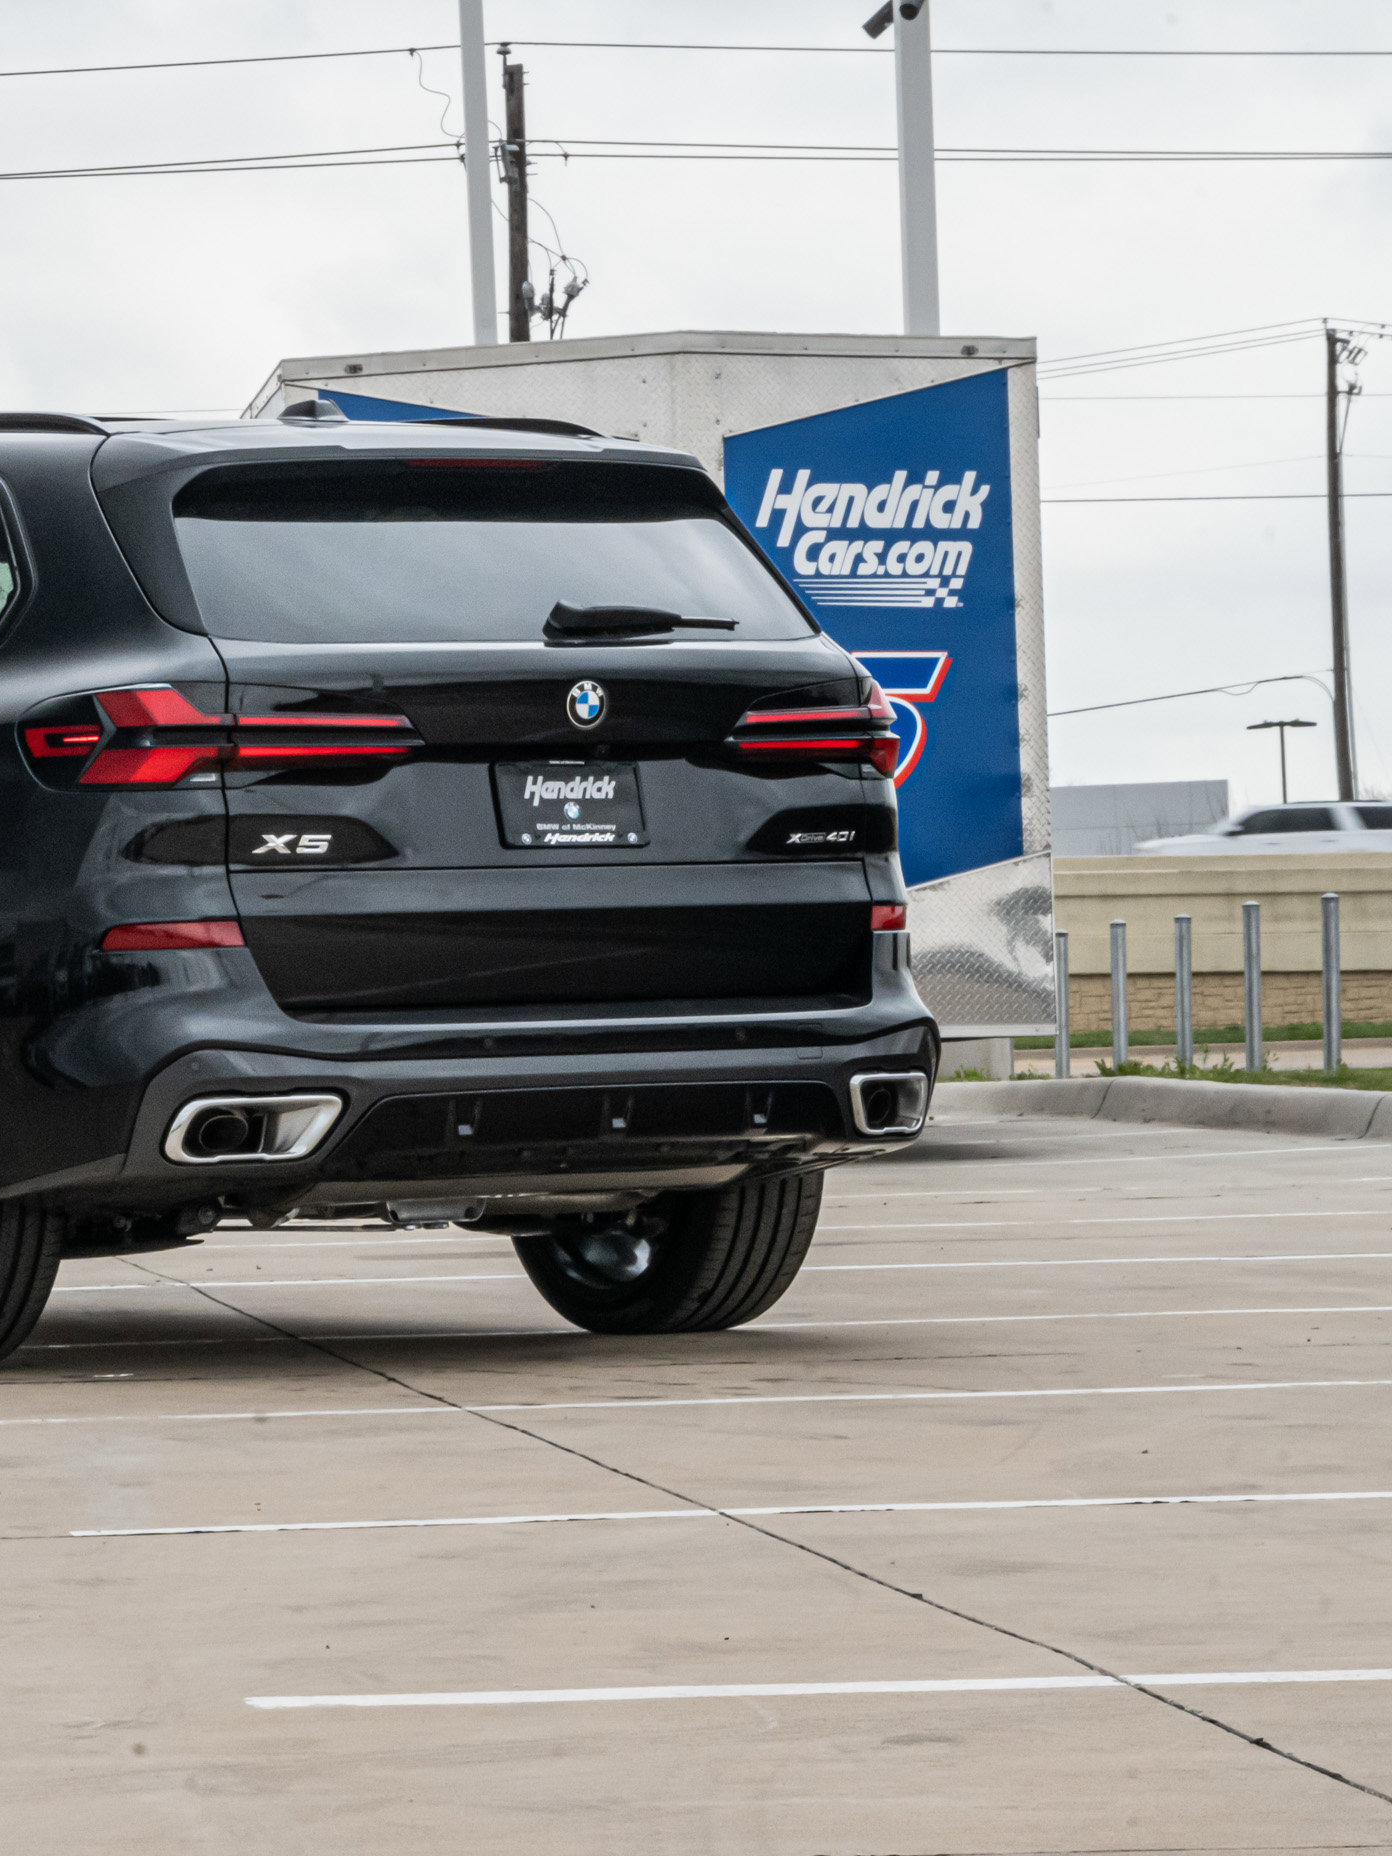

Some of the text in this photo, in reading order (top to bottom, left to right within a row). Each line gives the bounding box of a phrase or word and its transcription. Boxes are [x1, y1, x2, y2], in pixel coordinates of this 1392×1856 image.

[755, 468, 990, 547] Hendrick
[793, 530, 973, 576] Cars.com
[523, 775, 617, 807] Hendrick
[536, 823, 616, 832] BMW of McKinney
[543, 832, 616, 845] Hendrick
[251, 834, 332, 854] X5
